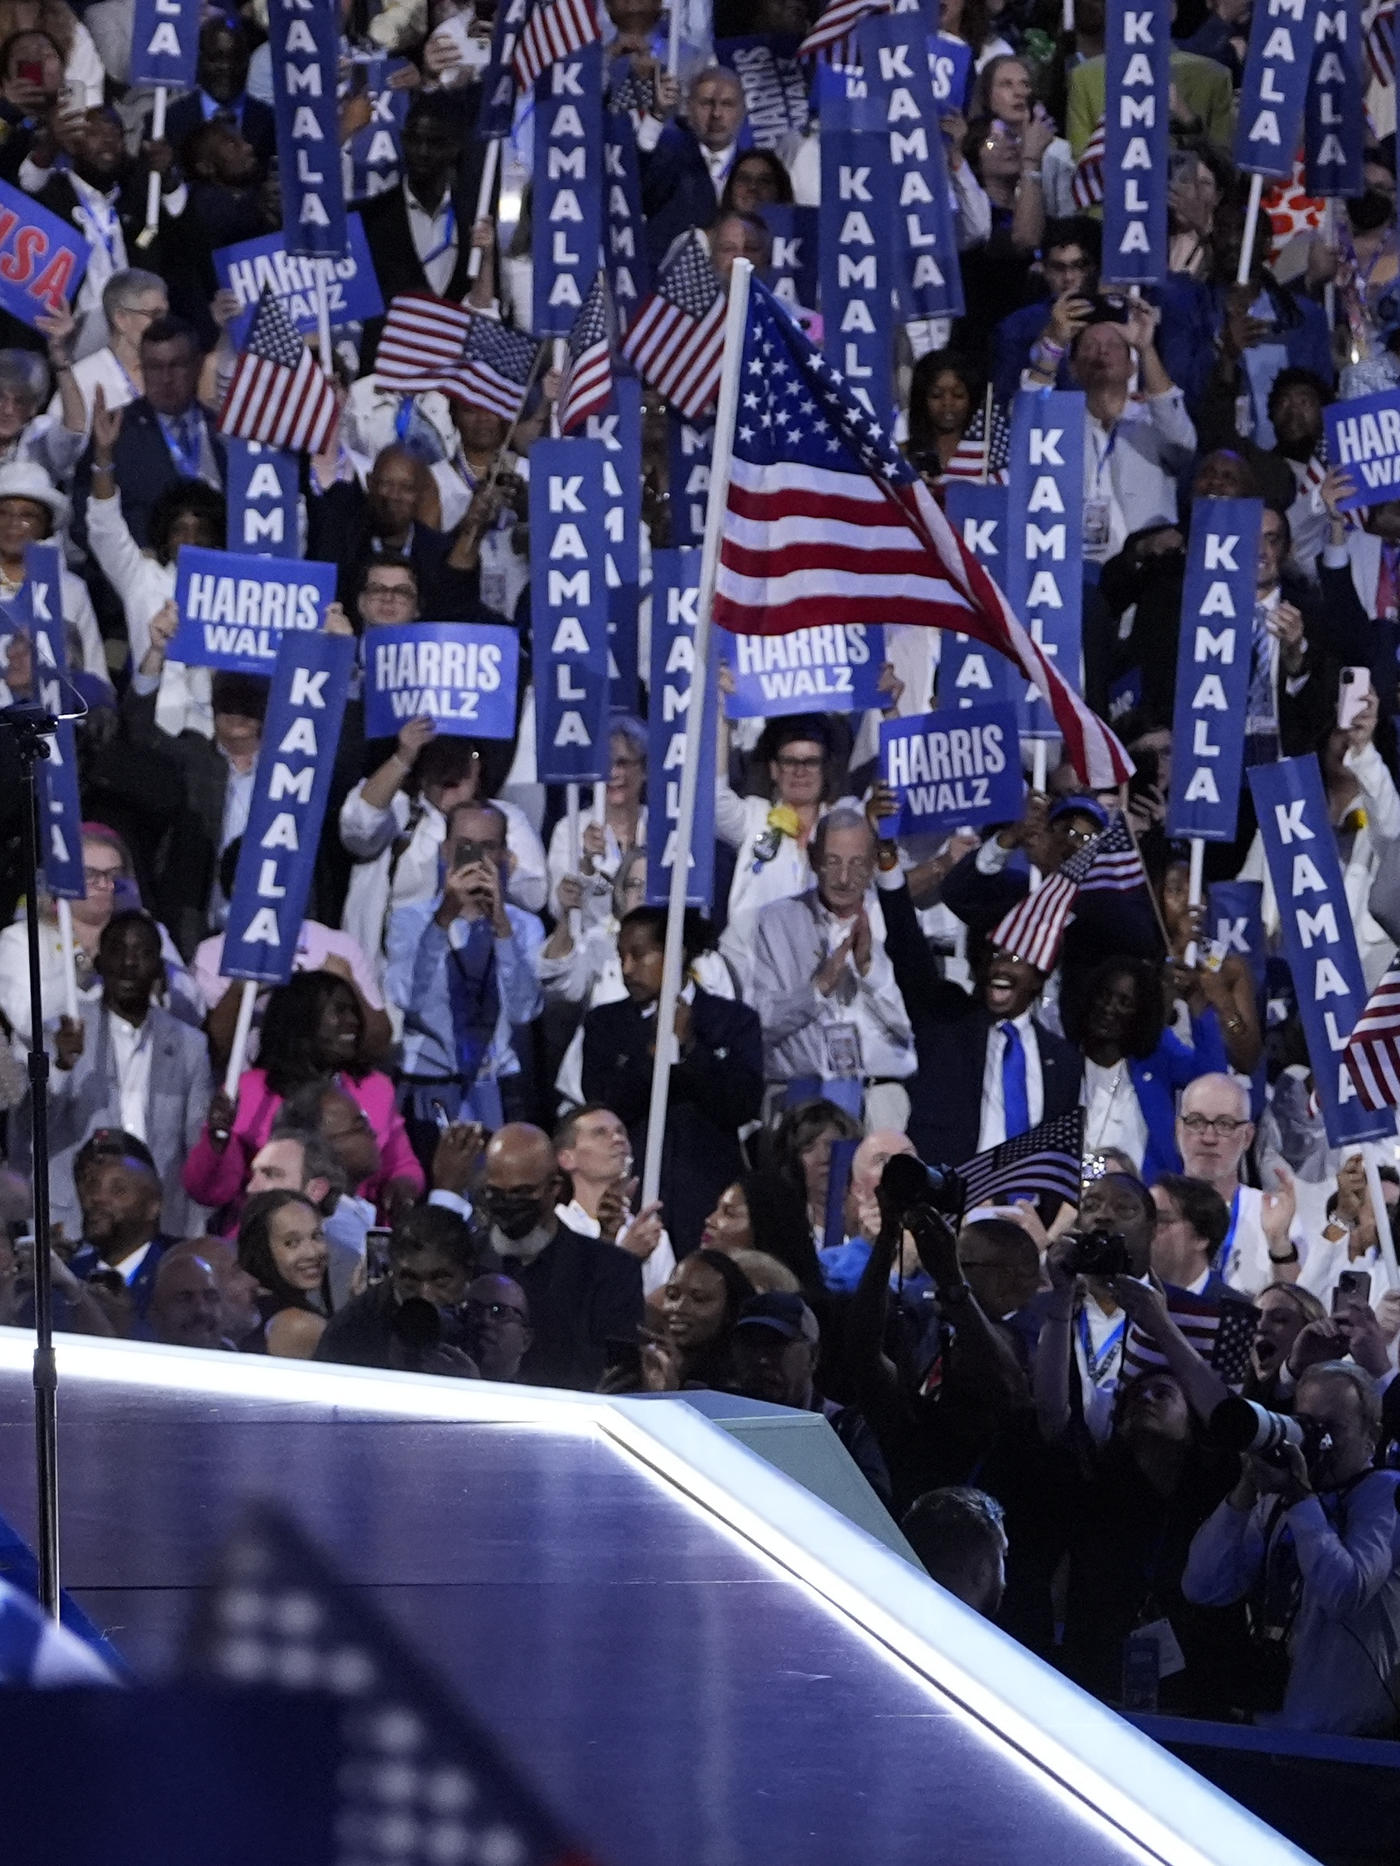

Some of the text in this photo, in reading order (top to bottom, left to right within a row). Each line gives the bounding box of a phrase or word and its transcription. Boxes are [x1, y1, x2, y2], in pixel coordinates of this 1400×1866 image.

[1313, 0, 1348, 166] MALA
[1119, 11, 1156, 254] KAMALA
[548, 62, 586, 306] KAMALA
[878, 45, 946, 289] KAMALA
[186, 572, 321, 631] HARRIS
[548, 474, 593, 748] KAMALA
[203, 624, 284, 659] WAL
[375, 640, 502, 693] HARRIS
[735, 622, 871, 676] HARRIS
[1183, 533, 1241, 805] KAMALA
[391, 687, 479, 720] WALZ
[759, 665, 855, 700] WALZ
[887, 723, 1006, 788] HARRIS
[241, 666, 329, 948] KAMALA
[907, 777, 991, 816] WALZ
